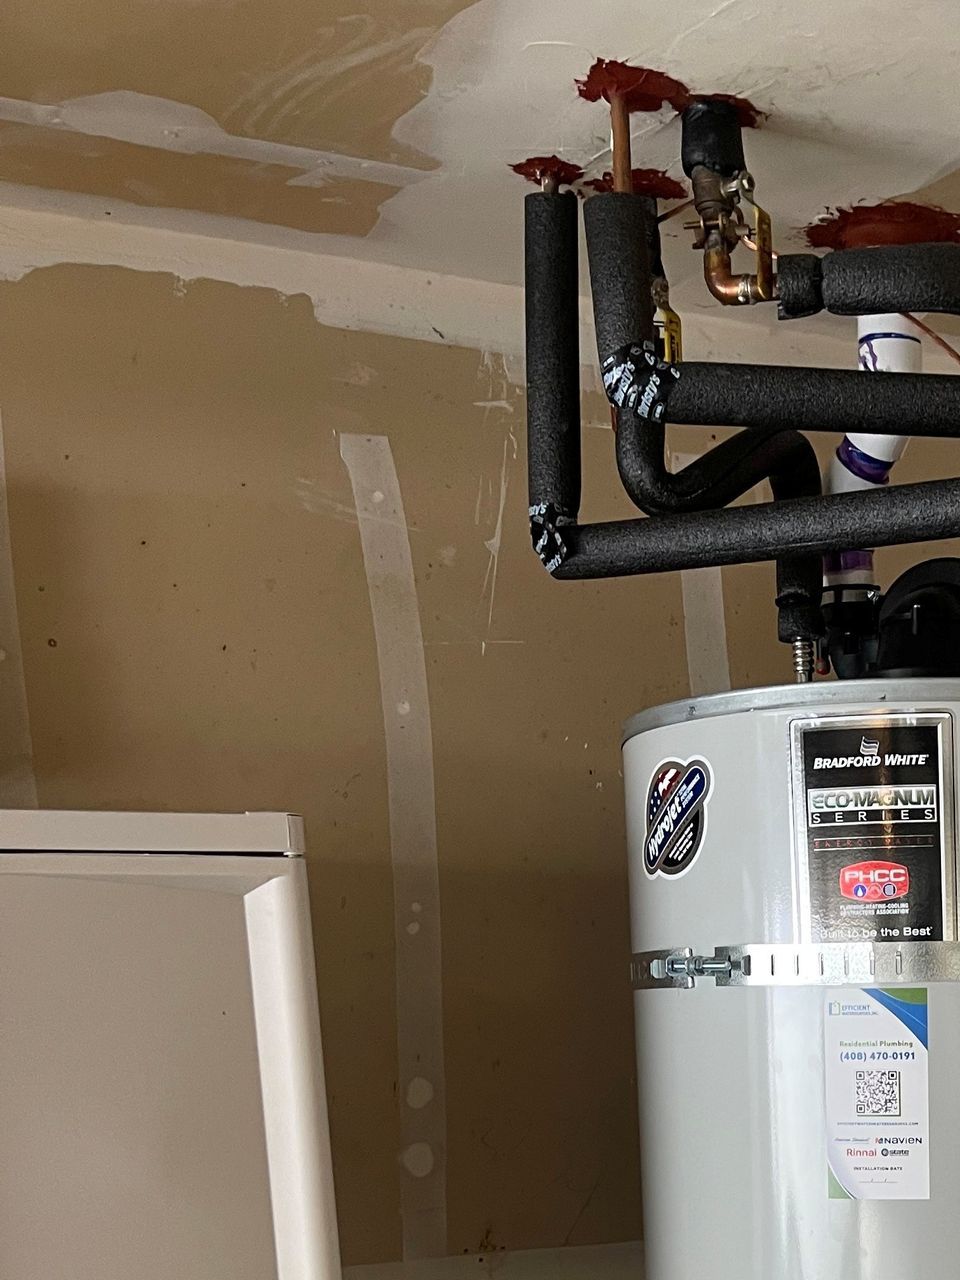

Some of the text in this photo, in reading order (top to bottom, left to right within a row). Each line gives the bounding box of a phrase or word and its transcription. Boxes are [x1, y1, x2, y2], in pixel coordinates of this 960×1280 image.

[814, 755, 882, 769] BRADFORD
[812, 789, 934, 809] ECO-MAGNUM
[812, 809, 933, 824] SERIES
[648, 795, 683, 861] Hydrojet
[844, 869, 906, 883] PHCC
[880, 927, 900, 937] the
[903, 926, 932, 936] Best
[841, 1004, 870, 1012] EFFICIENT
[840, 1051, 916, 1063] (408) 470-0191
[846, 1148, 877, 1157] Rinnai
